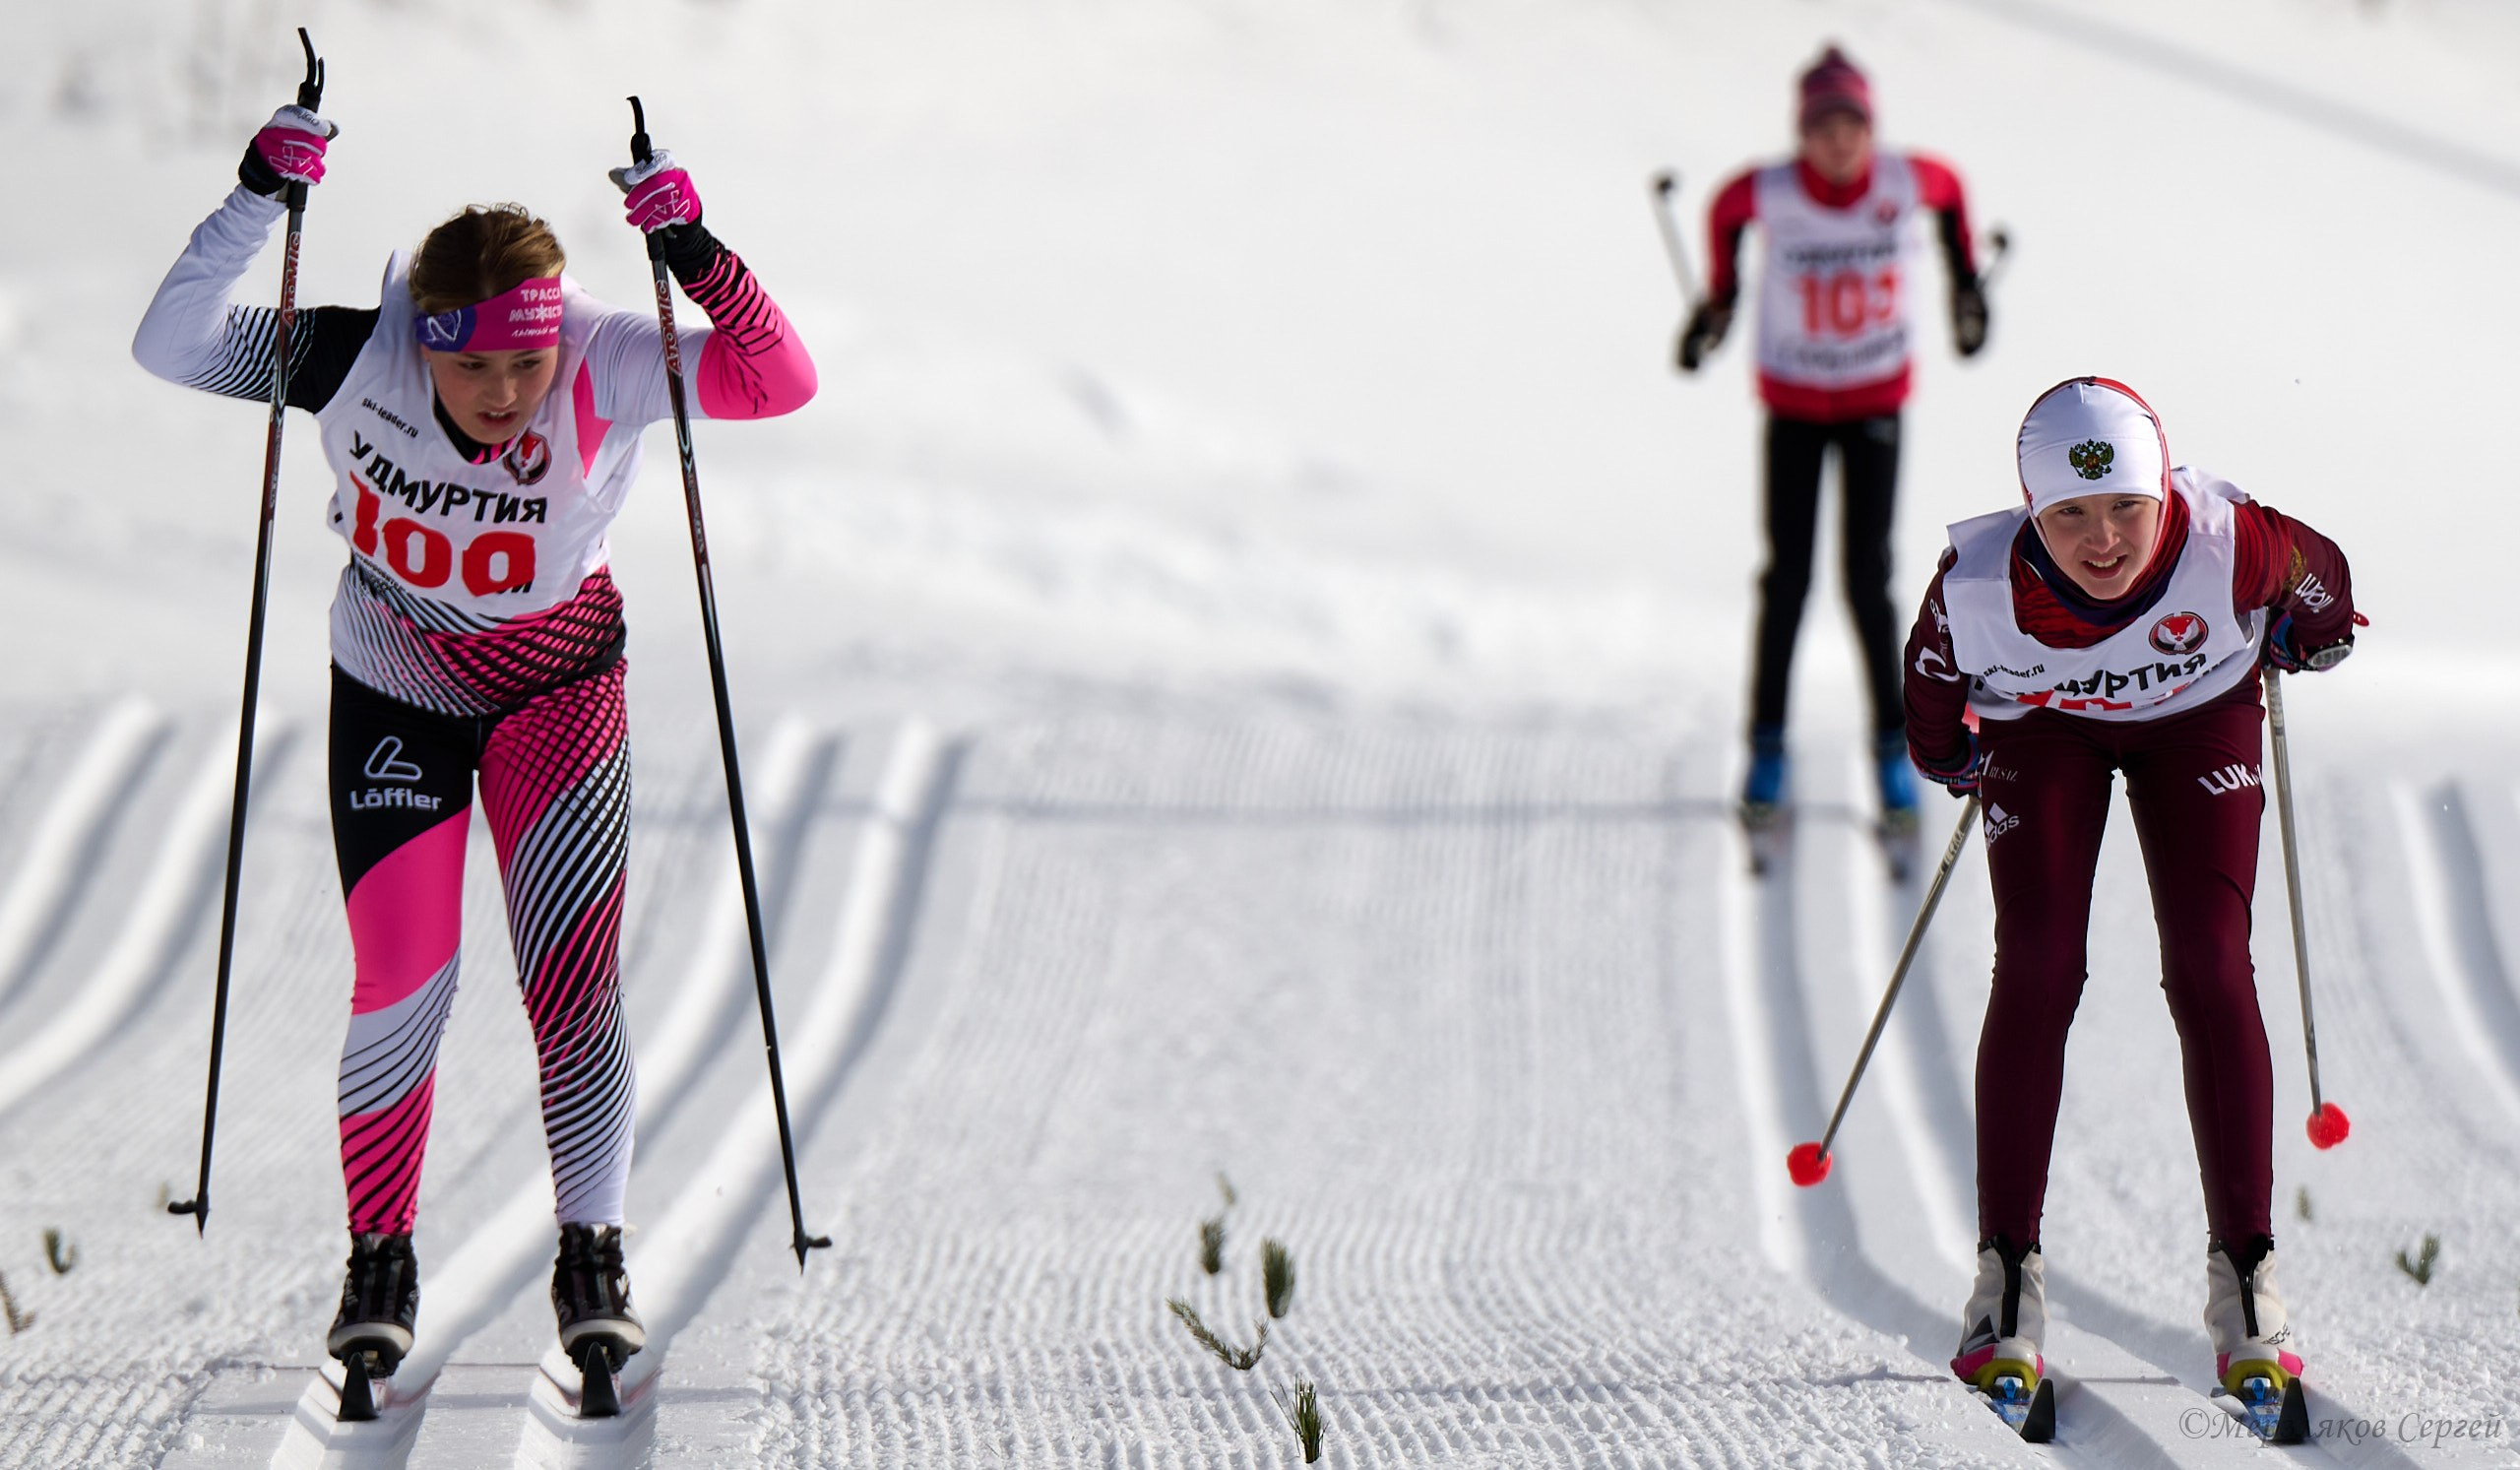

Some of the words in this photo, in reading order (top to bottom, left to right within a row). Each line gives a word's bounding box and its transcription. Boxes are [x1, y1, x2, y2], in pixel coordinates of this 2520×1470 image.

[282, 230, 301, 329] ATOMIC
[656, 279, 682, 377] ATOMIC
[361, 398, 419, 439] ski-leader.ru
[349, 429, 547, 524] УДМУРТИЯ
[349, 470, 536, 598] 100
[349, 787, 443, 810] Löffler
